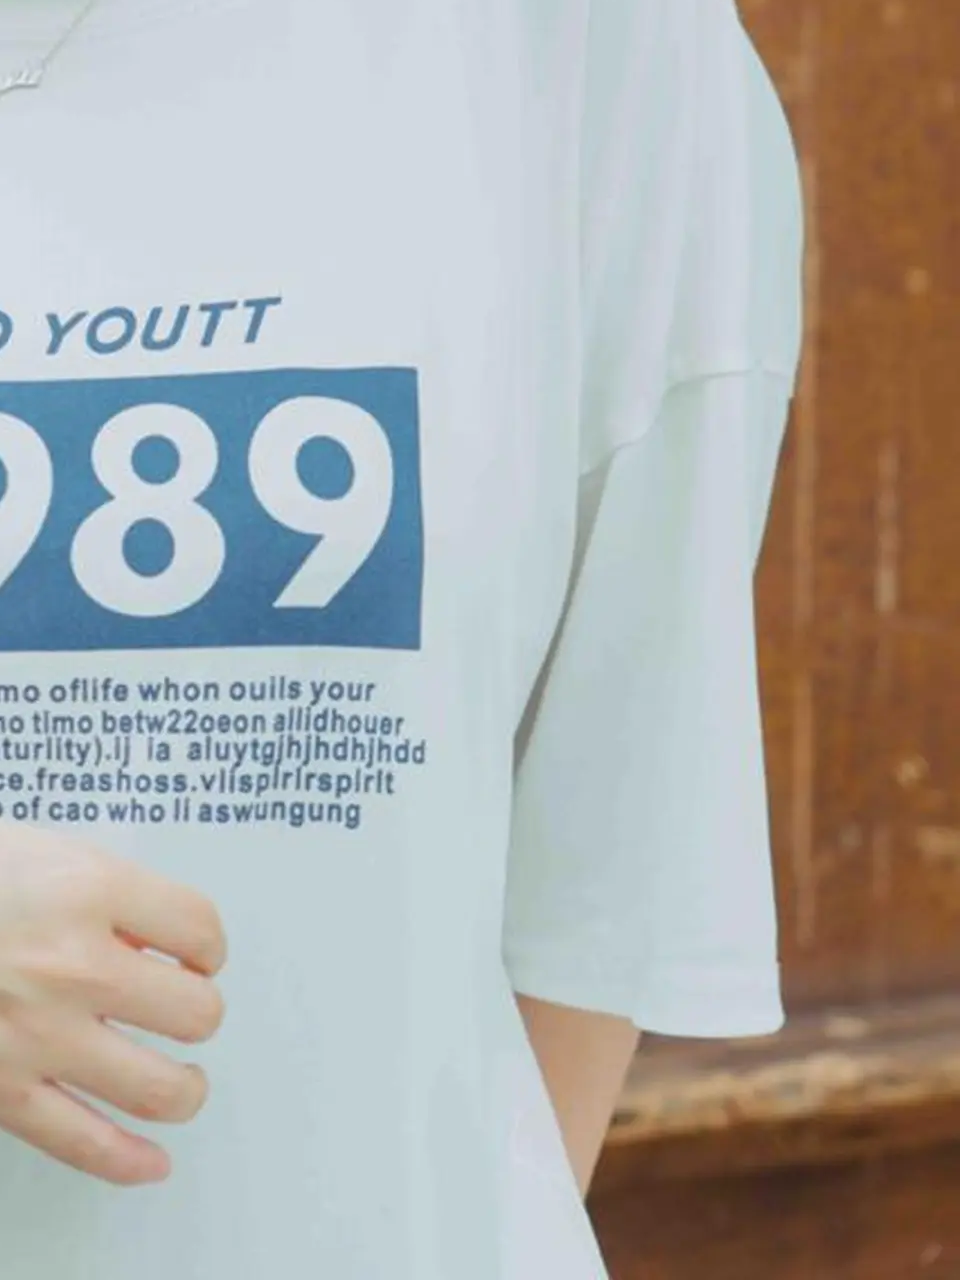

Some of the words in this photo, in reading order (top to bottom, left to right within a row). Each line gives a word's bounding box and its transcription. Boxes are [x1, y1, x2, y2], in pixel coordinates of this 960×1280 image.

[44, 296, 282, 355] YOUTT
[138, 676, 220, 702] whon
[309, 680, 376, 706] your
[12, 797, 40, 821] of
[48, 800, 99, 822] cao
[107, 798, 166, 823] who
